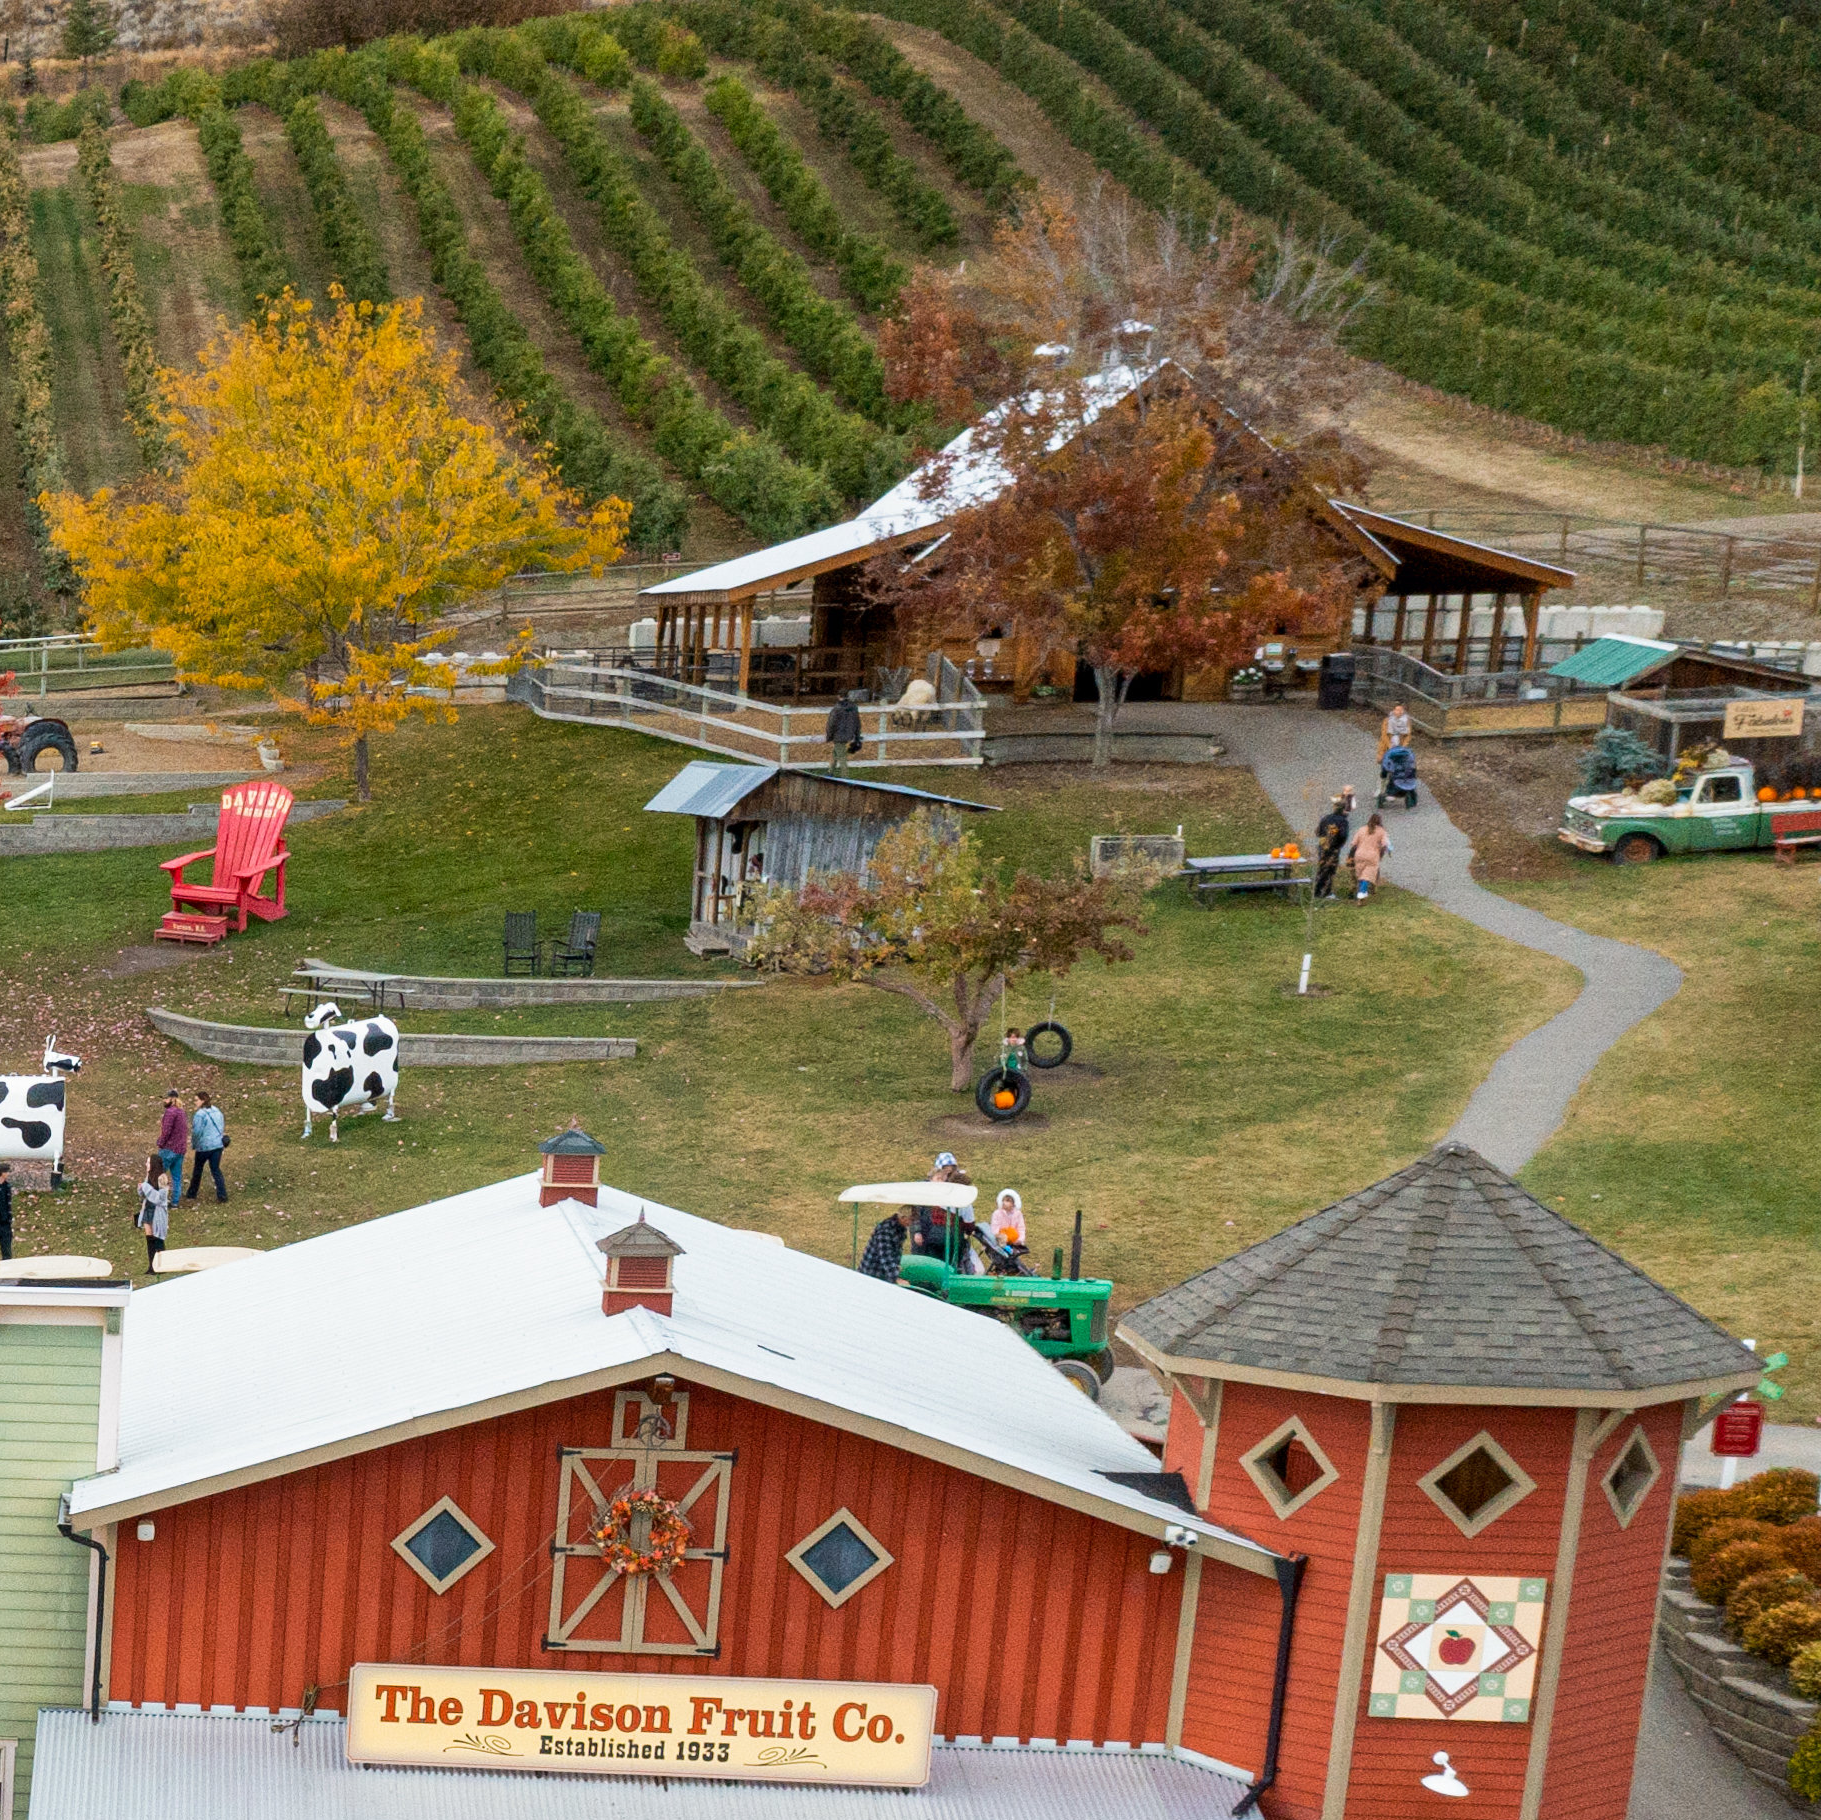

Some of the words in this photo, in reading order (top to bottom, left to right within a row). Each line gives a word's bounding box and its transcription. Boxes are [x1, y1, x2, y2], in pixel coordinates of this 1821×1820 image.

[222, 790, 291, 814] DAVISON
[375, 1684, 464, 1727] The
[477, 1688, 672, 1735] Davison
[687, 1696, 817, 1741] Fruit
[832, 1703, 906, 1744] Co.
[539, 1735, 666, 1761] Established
[675, 1742, 731, 1763] 1933
